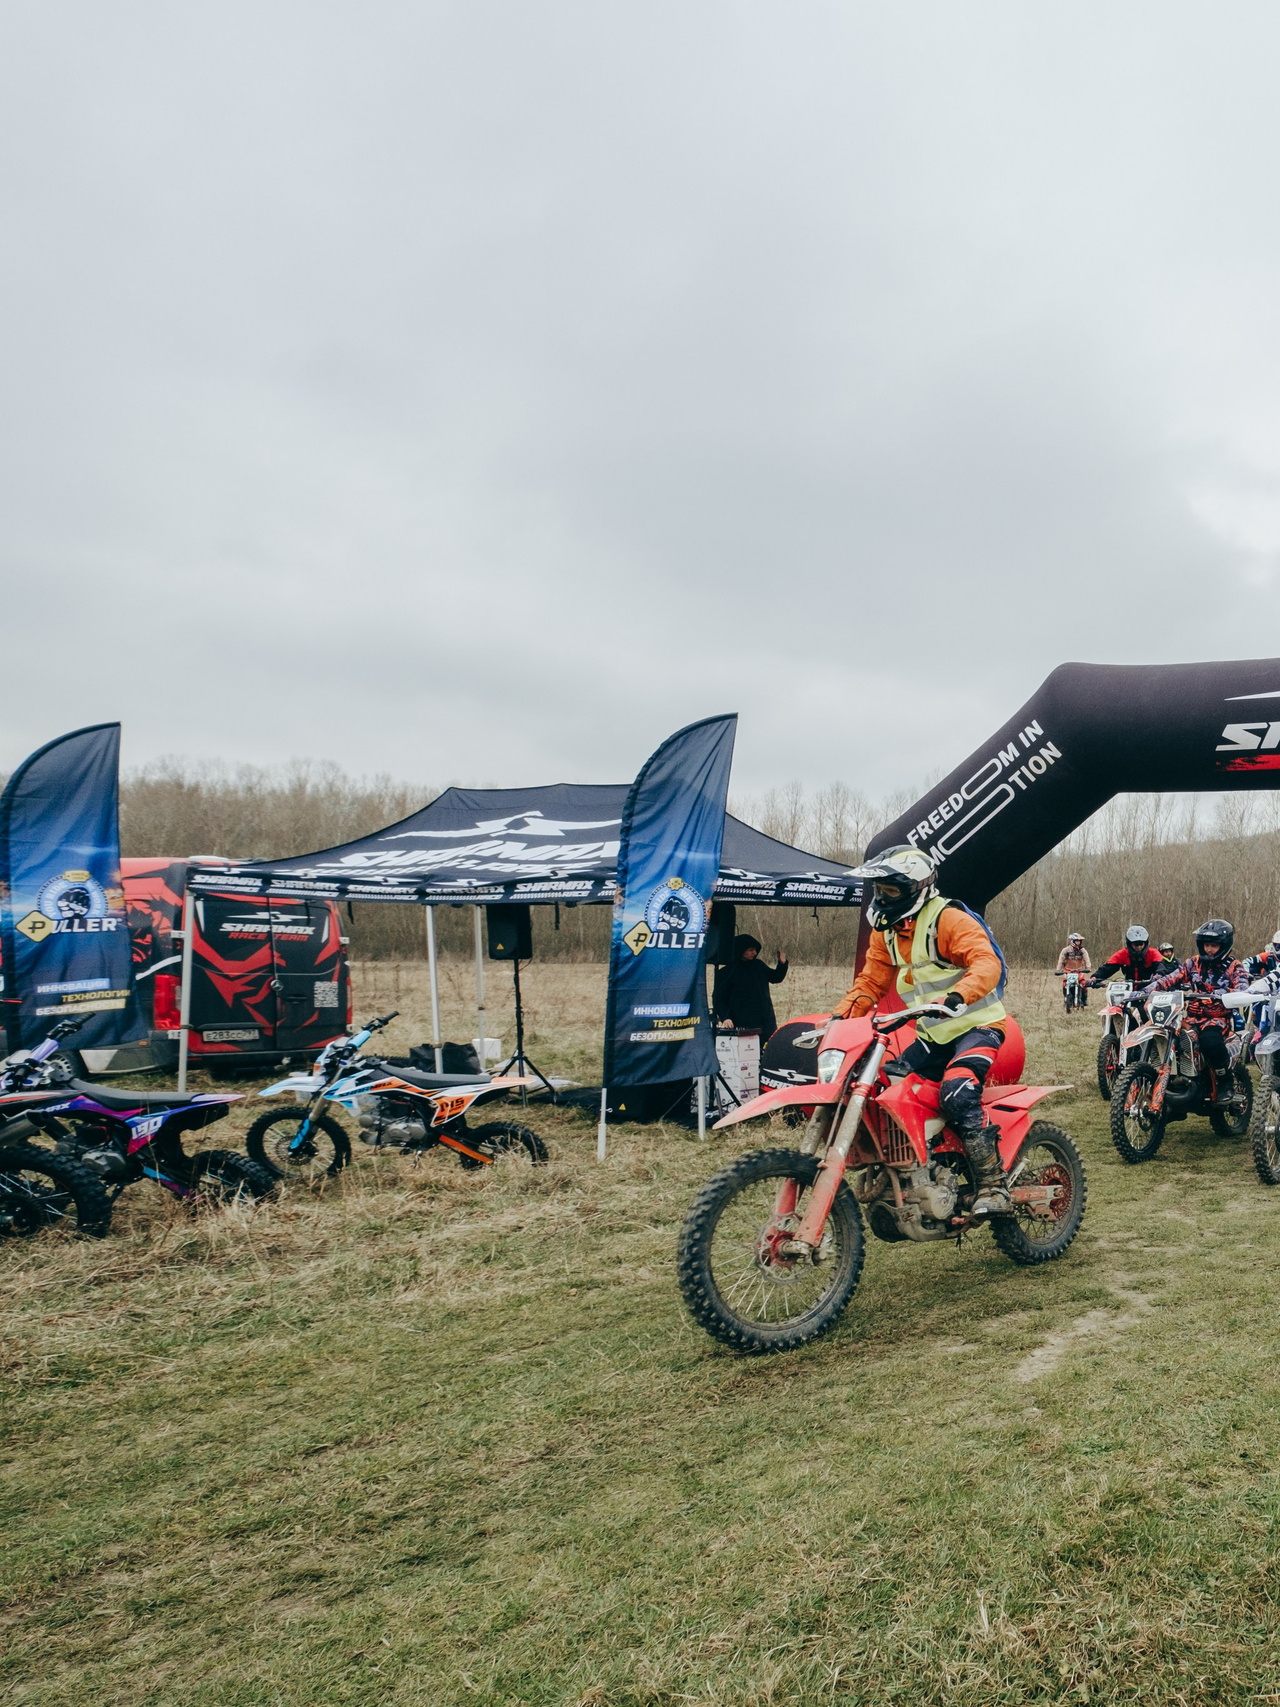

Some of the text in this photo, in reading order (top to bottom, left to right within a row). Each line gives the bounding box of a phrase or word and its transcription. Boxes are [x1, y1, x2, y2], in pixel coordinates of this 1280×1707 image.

[906, 719, 1044, 848] FREEDOM IN
[193, 875, 263, 887] SHARMAX
[270, 879, 341, 891] SHARMAX
[514, 880, 595, 892] SHARMAX
[716, 878, 781, 890] HARMAX
[751, 889, 776, 897] RACE
[784, 881, 847, 895] SHARMAX
[823, 894, 845, 902] RACE
[219, 923, 316, 935] SHARMAX
[228, 932, 269, 940] RACE
[37, 979, 108, 994] ИННОВАЦИИ
[61, 990, 131, 1003] ТЕХНОЛОГИИ
[36, 1001, 126, 1016] БЕЗОПАСНОСТЬ
[131, 1115, 164, 1139] 190
